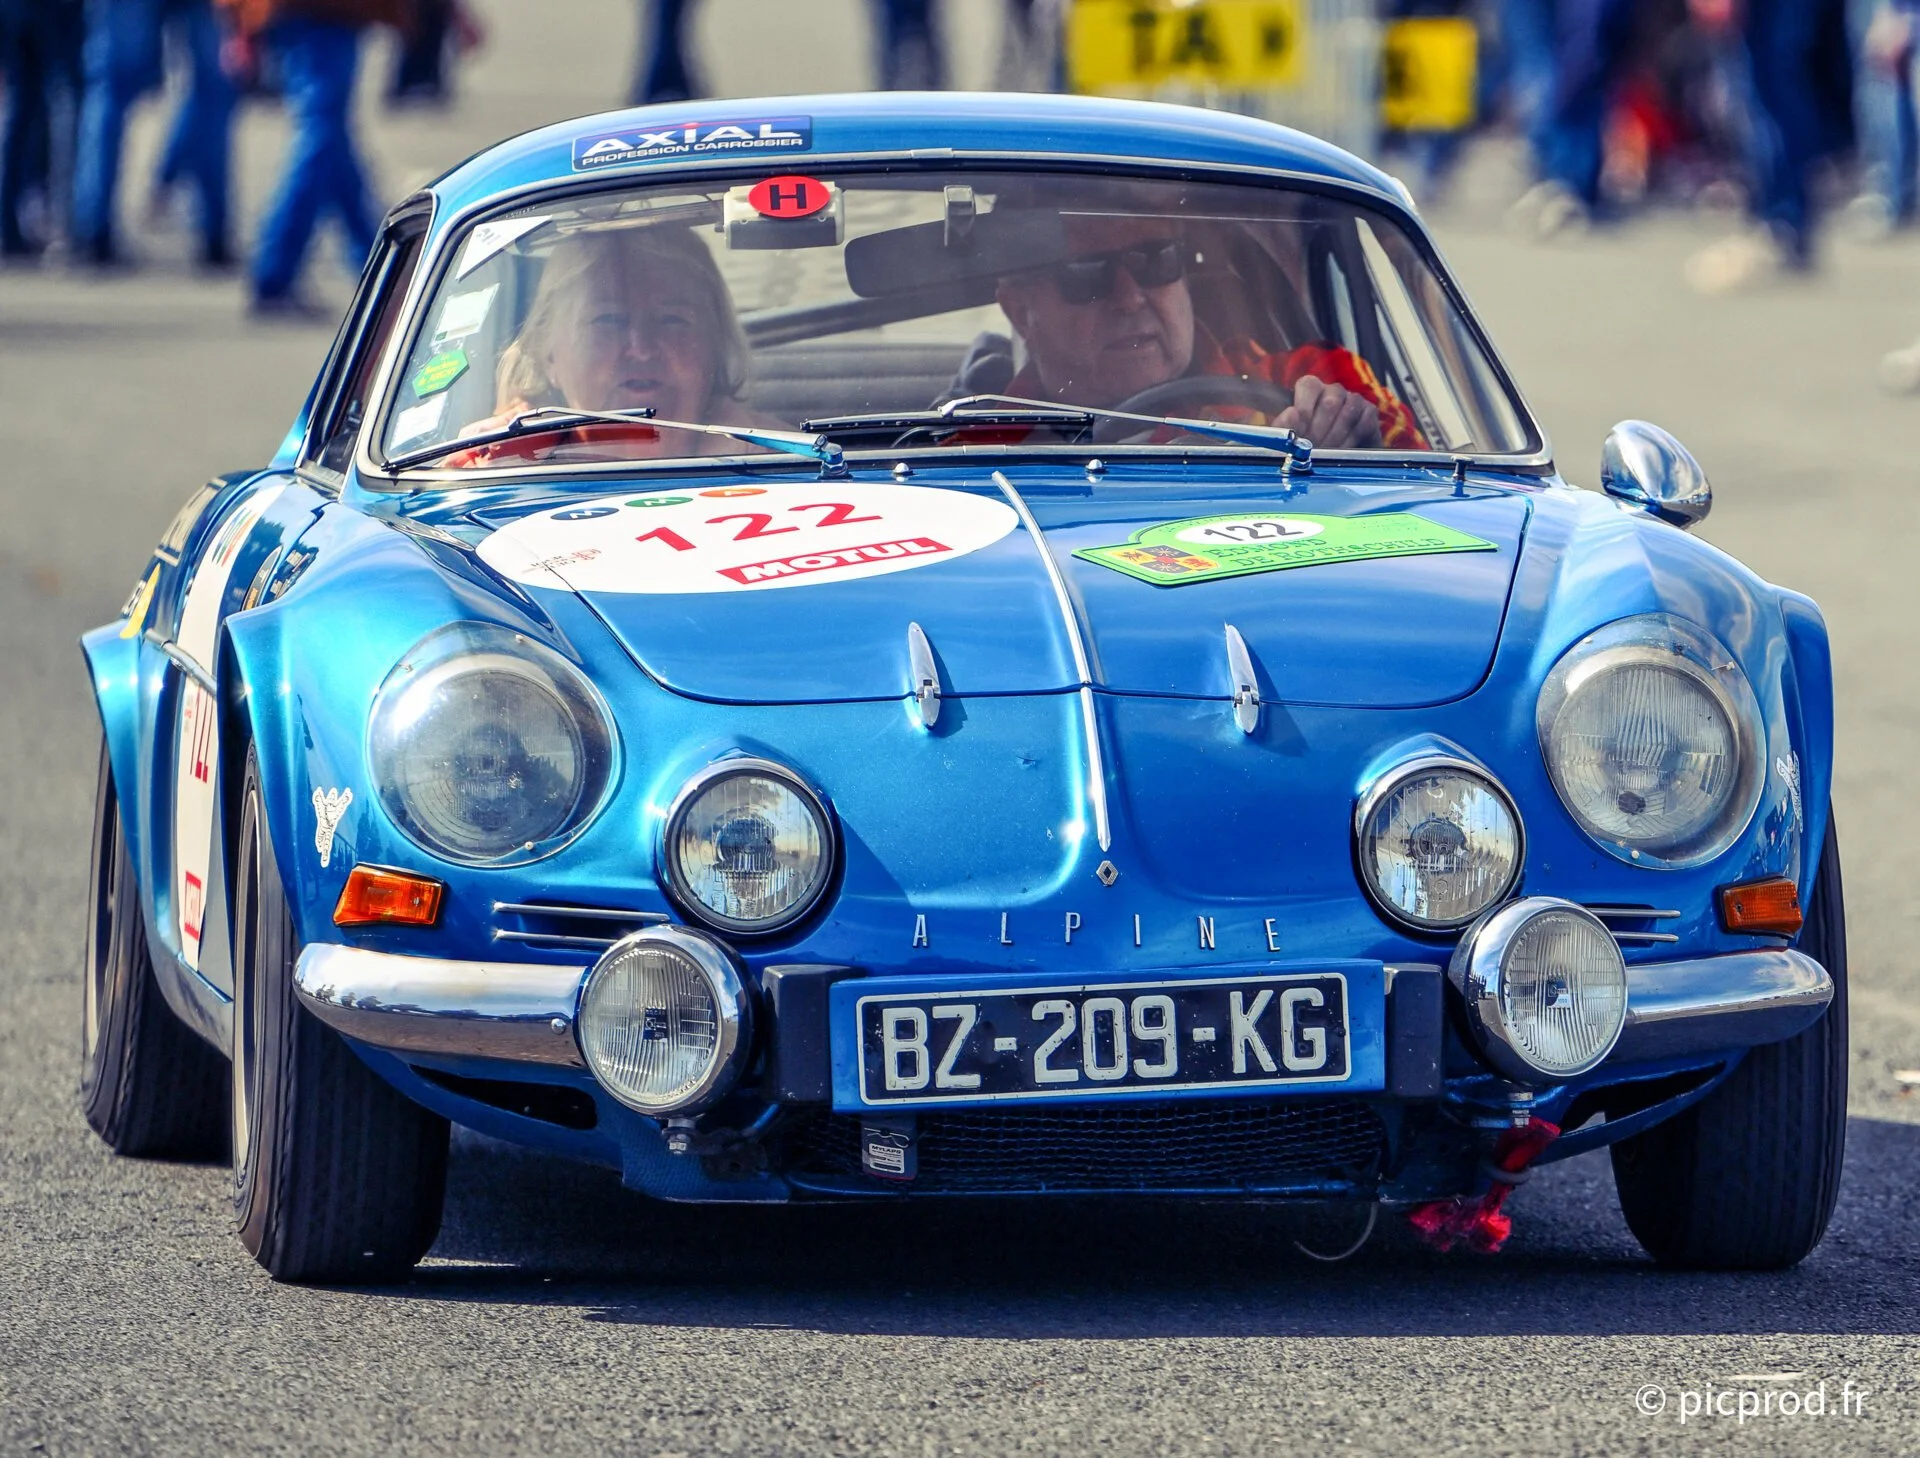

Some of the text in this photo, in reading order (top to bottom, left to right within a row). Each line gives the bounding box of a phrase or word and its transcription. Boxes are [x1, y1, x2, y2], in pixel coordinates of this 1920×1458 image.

[581, 138, 803, 166] PROFESSION CARROSSIER
[769, 183, 807, 210] H
[635, 503, 884, 551] 122
[1204, 522, 1304, 541] 122
[740, 540, 937, 582] MOTUL
[1203, 539, 1327, 558] EDMOND
[1230, 538, 1446, 566] DE ROTHSCHILD
[912, 911, 1281, 951] ALPINE
[882, 987, 1326, 1091] BZ-209-KG
